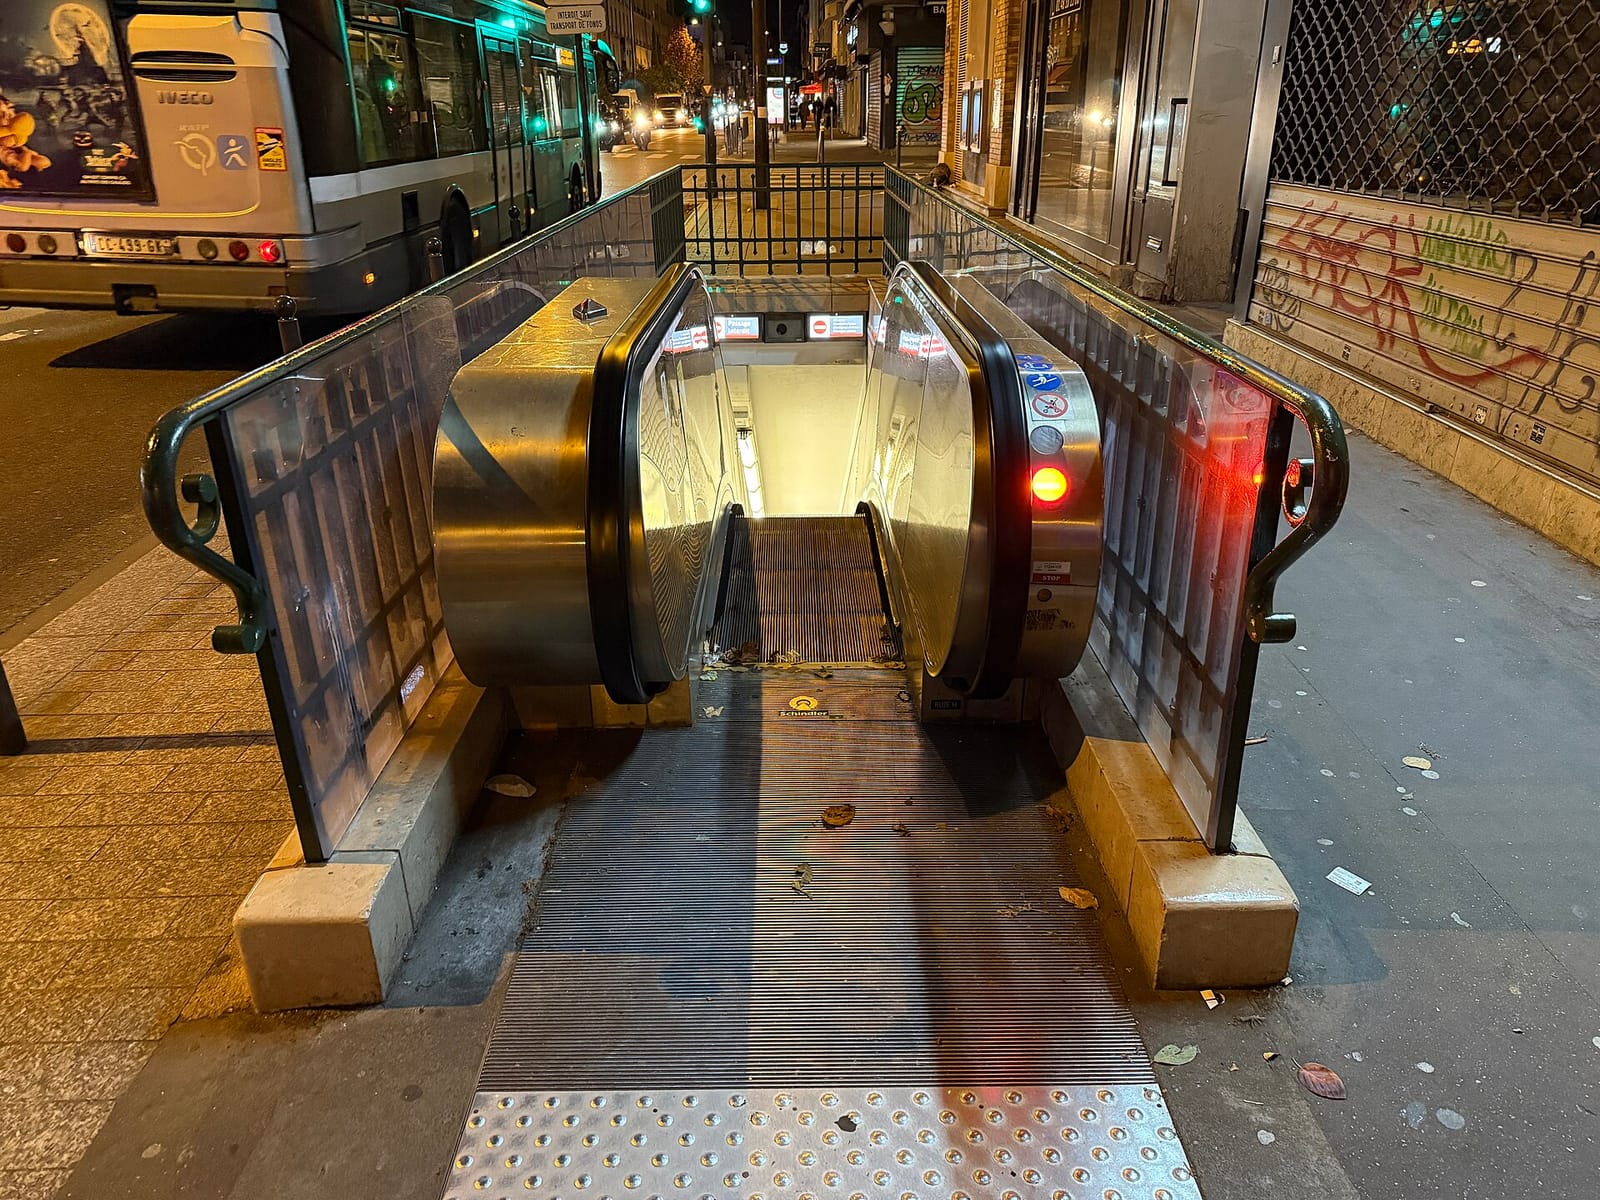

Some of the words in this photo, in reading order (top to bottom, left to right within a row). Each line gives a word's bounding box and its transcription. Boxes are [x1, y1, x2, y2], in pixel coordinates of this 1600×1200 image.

[557, 10, 578, 19] INTERDIT
[579, 9, 592, 18] SAUF
[550, 21, 577, 29] TRANSPORT
[578, 20, 586, 28] DE
[586, 19, 603, 28] FONDS
[157, 91, 214, 105] IVECO
